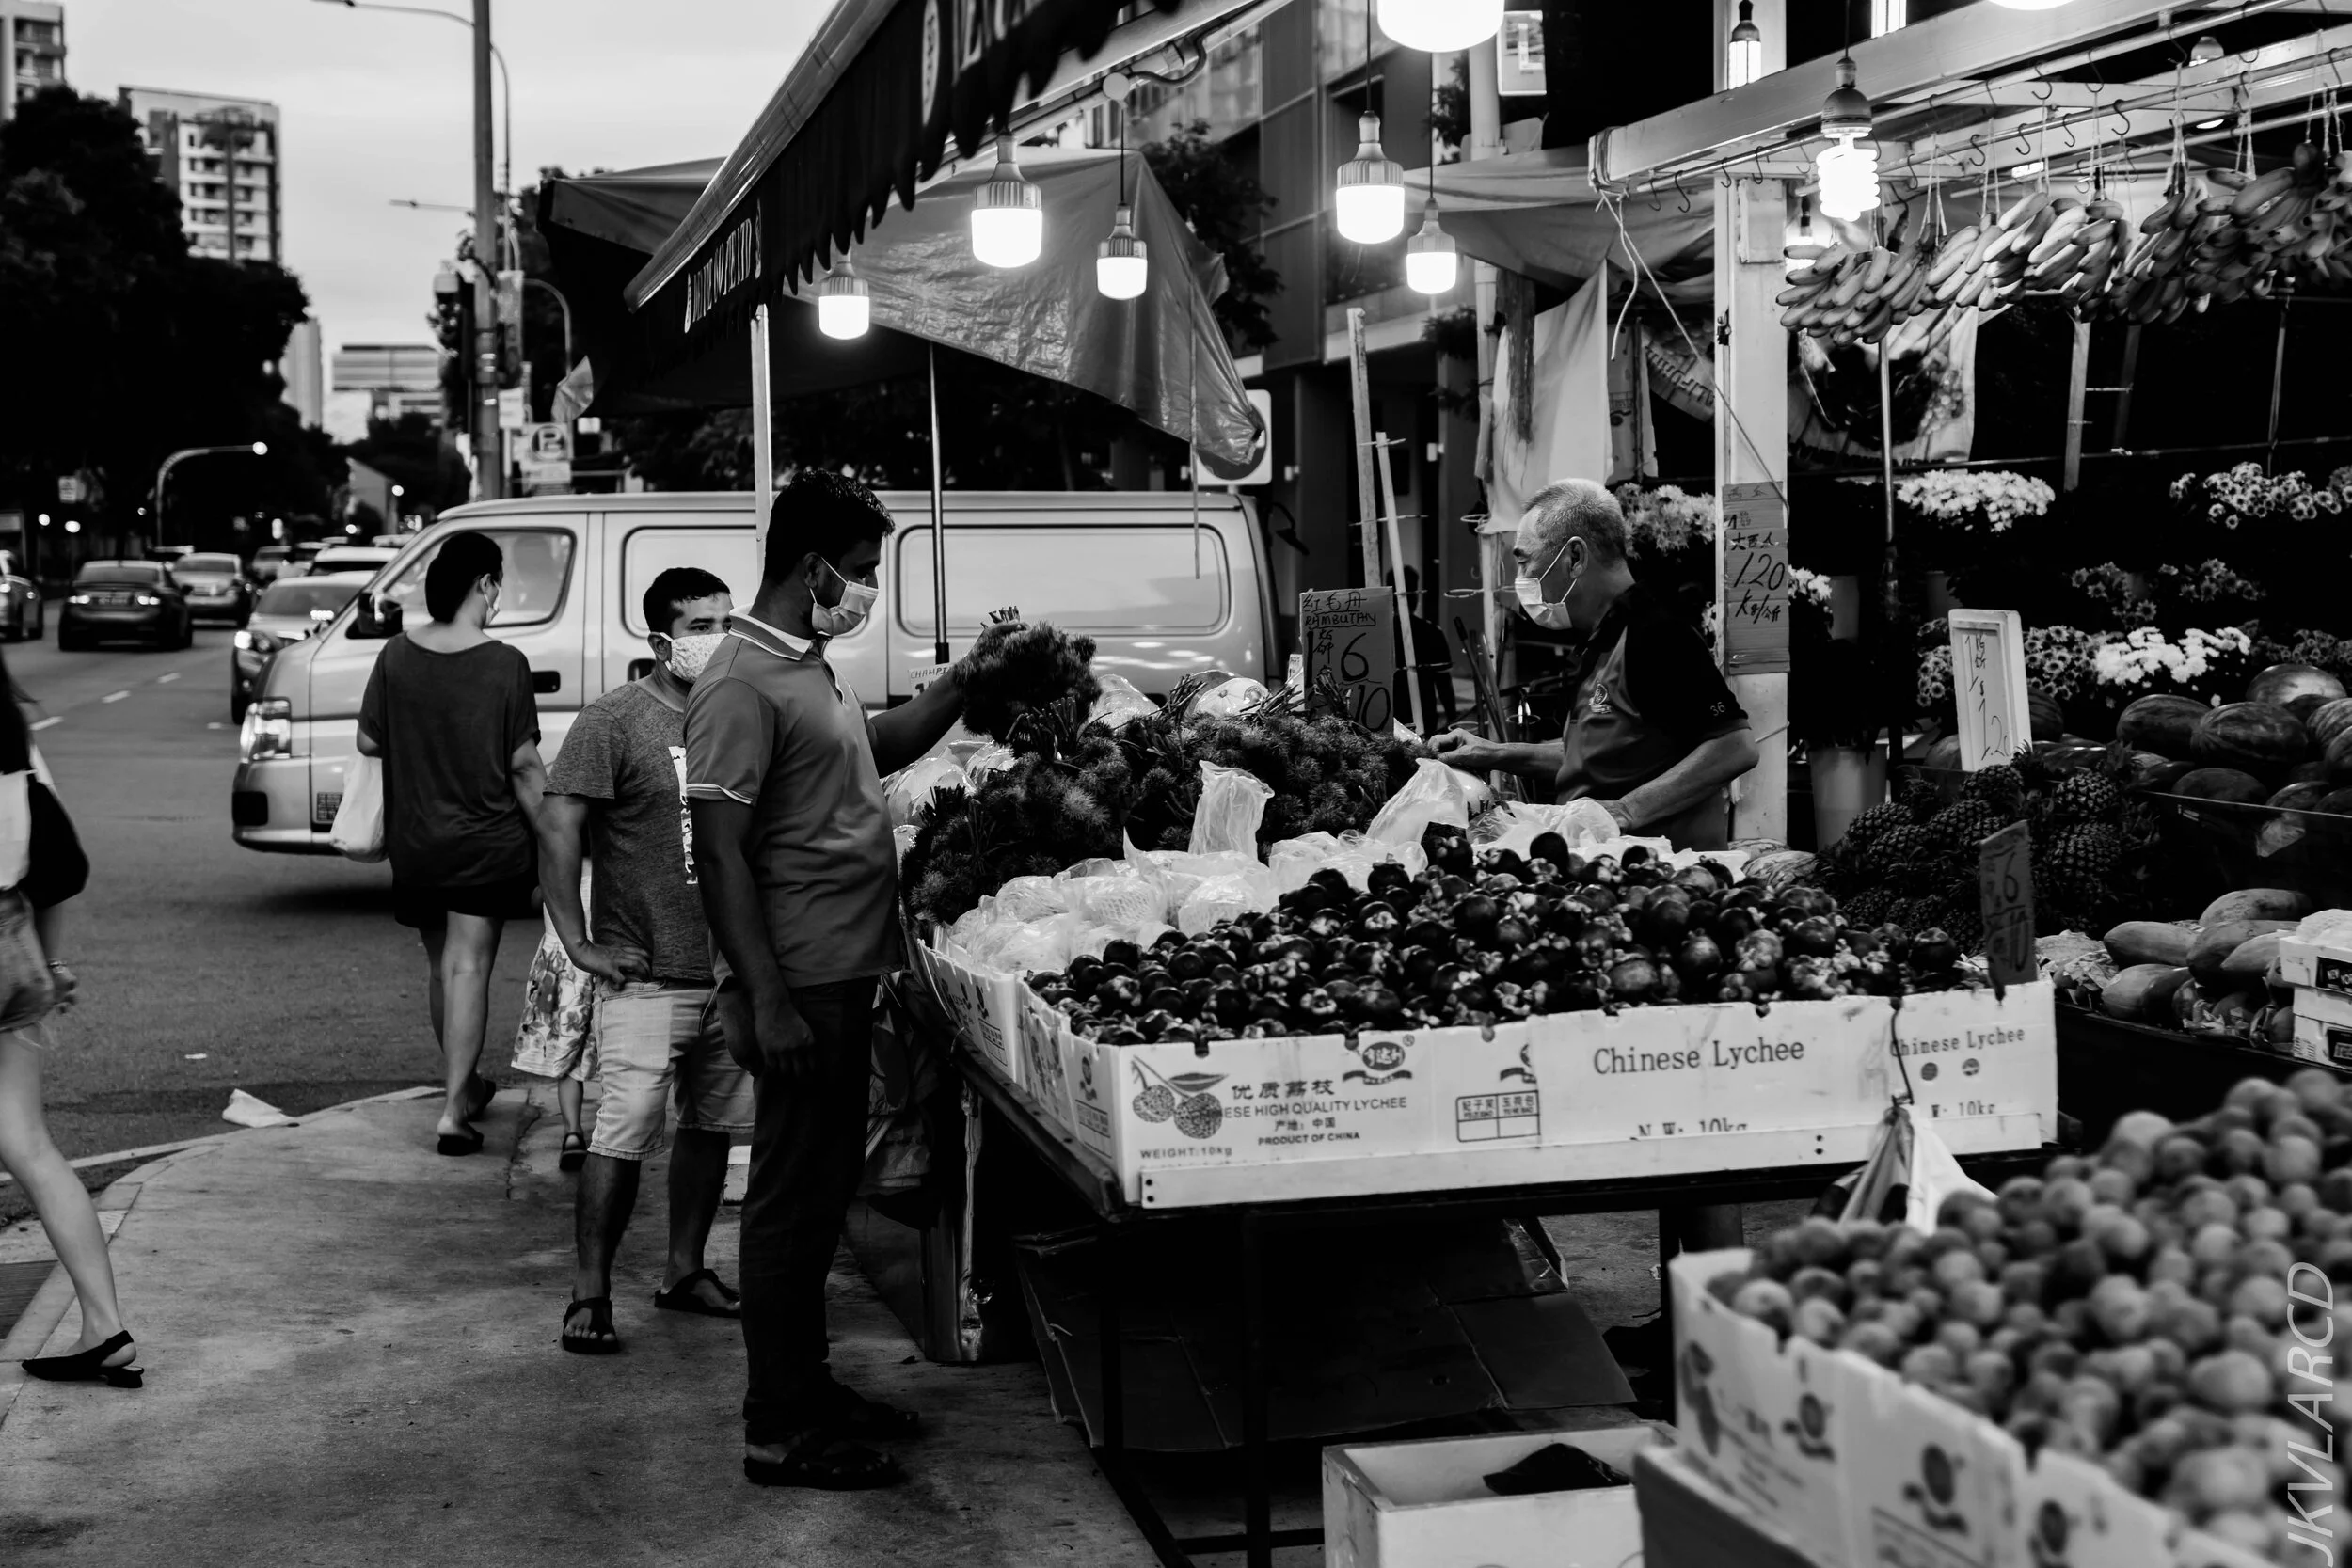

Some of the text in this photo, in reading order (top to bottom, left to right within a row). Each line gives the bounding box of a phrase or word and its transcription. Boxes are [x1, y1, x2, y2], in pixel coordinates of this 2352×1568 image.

[1305, 611, 1376, 626] RAMBUTAN
[1341, 632, 1369, 682] 6
[1710, 702, 1725, 716] 36
[1890, 1026, 2025, 1057] Chinese Lychee
[1593, 1036, 1804, 1074] Chinese Lychee
[1255, 1103, 1289, 1117] HIGH
[1292, 1101, 1351, 1115] QUALITY
[1354, 1097, 1407, 1111] LYCHEE
[1258, 1132, 1360, 1146] PRODUCT OF CHINA
